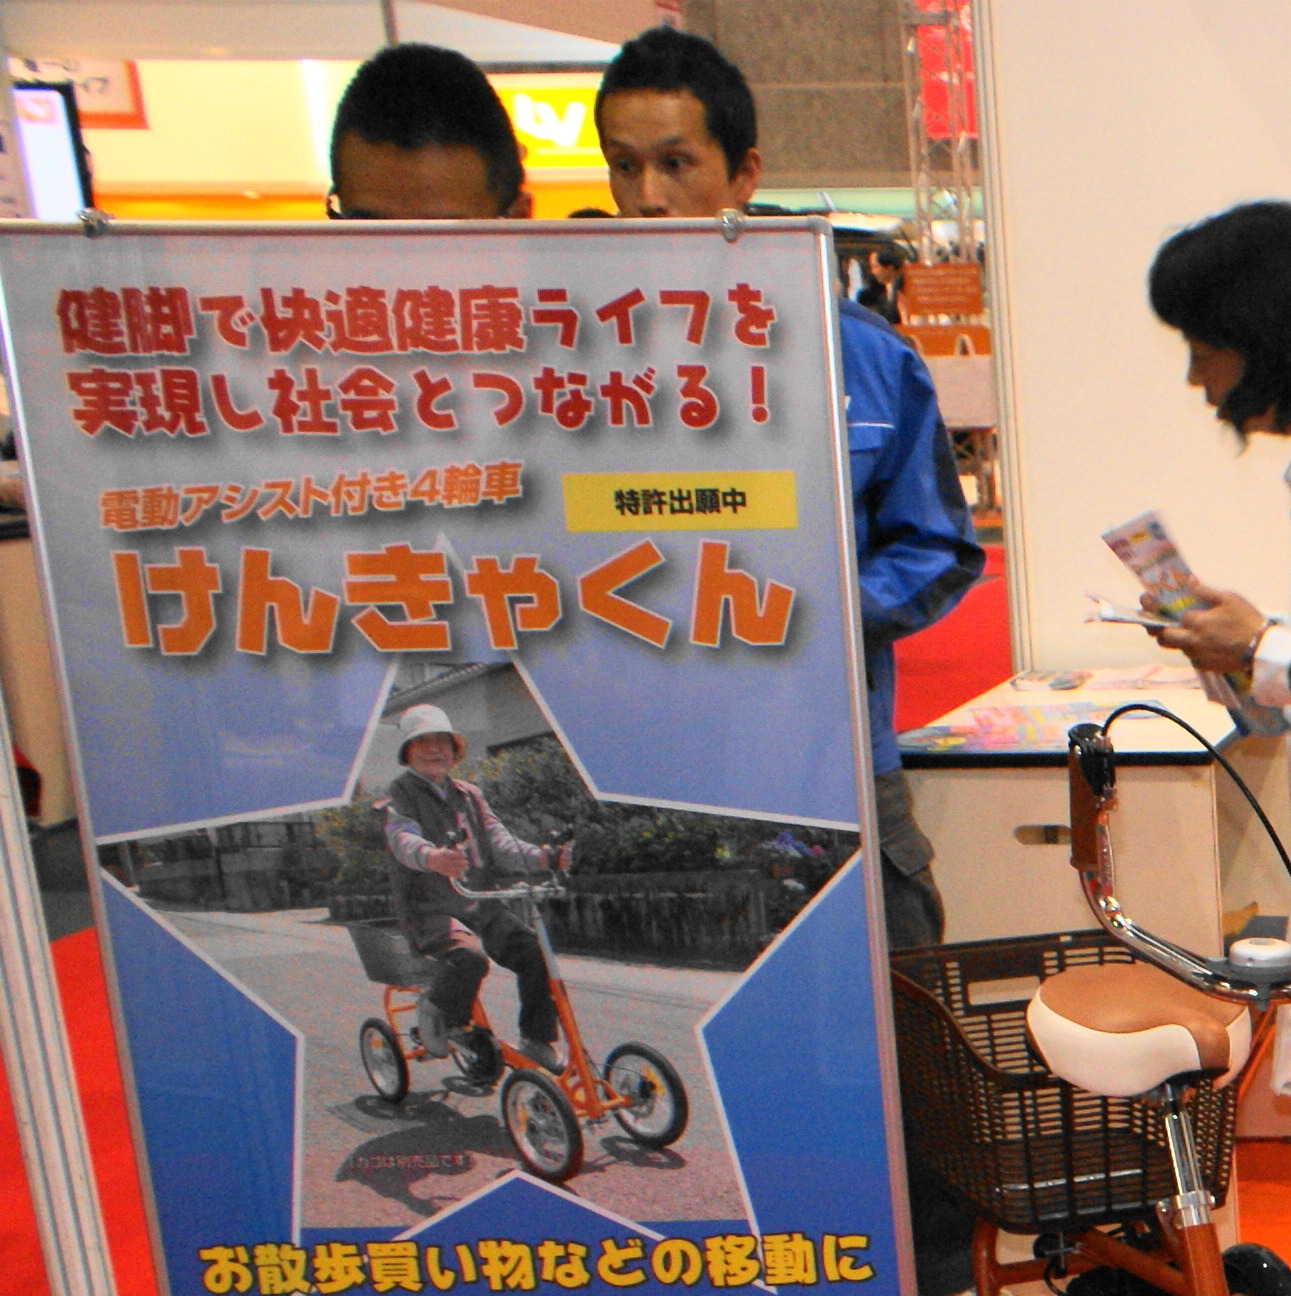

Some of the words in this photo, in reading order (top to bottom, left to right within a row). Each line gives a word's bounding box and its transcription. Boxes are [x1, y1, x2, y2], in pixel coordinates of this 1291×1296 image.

[58, 282, 777, 358] 健脚で快適健康ライフを
[99, 461, 524, 532] 電動アシスト付き4輪車
[613, 487, 748, 516] 特許出願中
[111, 538, 797, 656] けんきゃくん
[198, 1232, 874, 1296] お散歩買い物などの移動に
